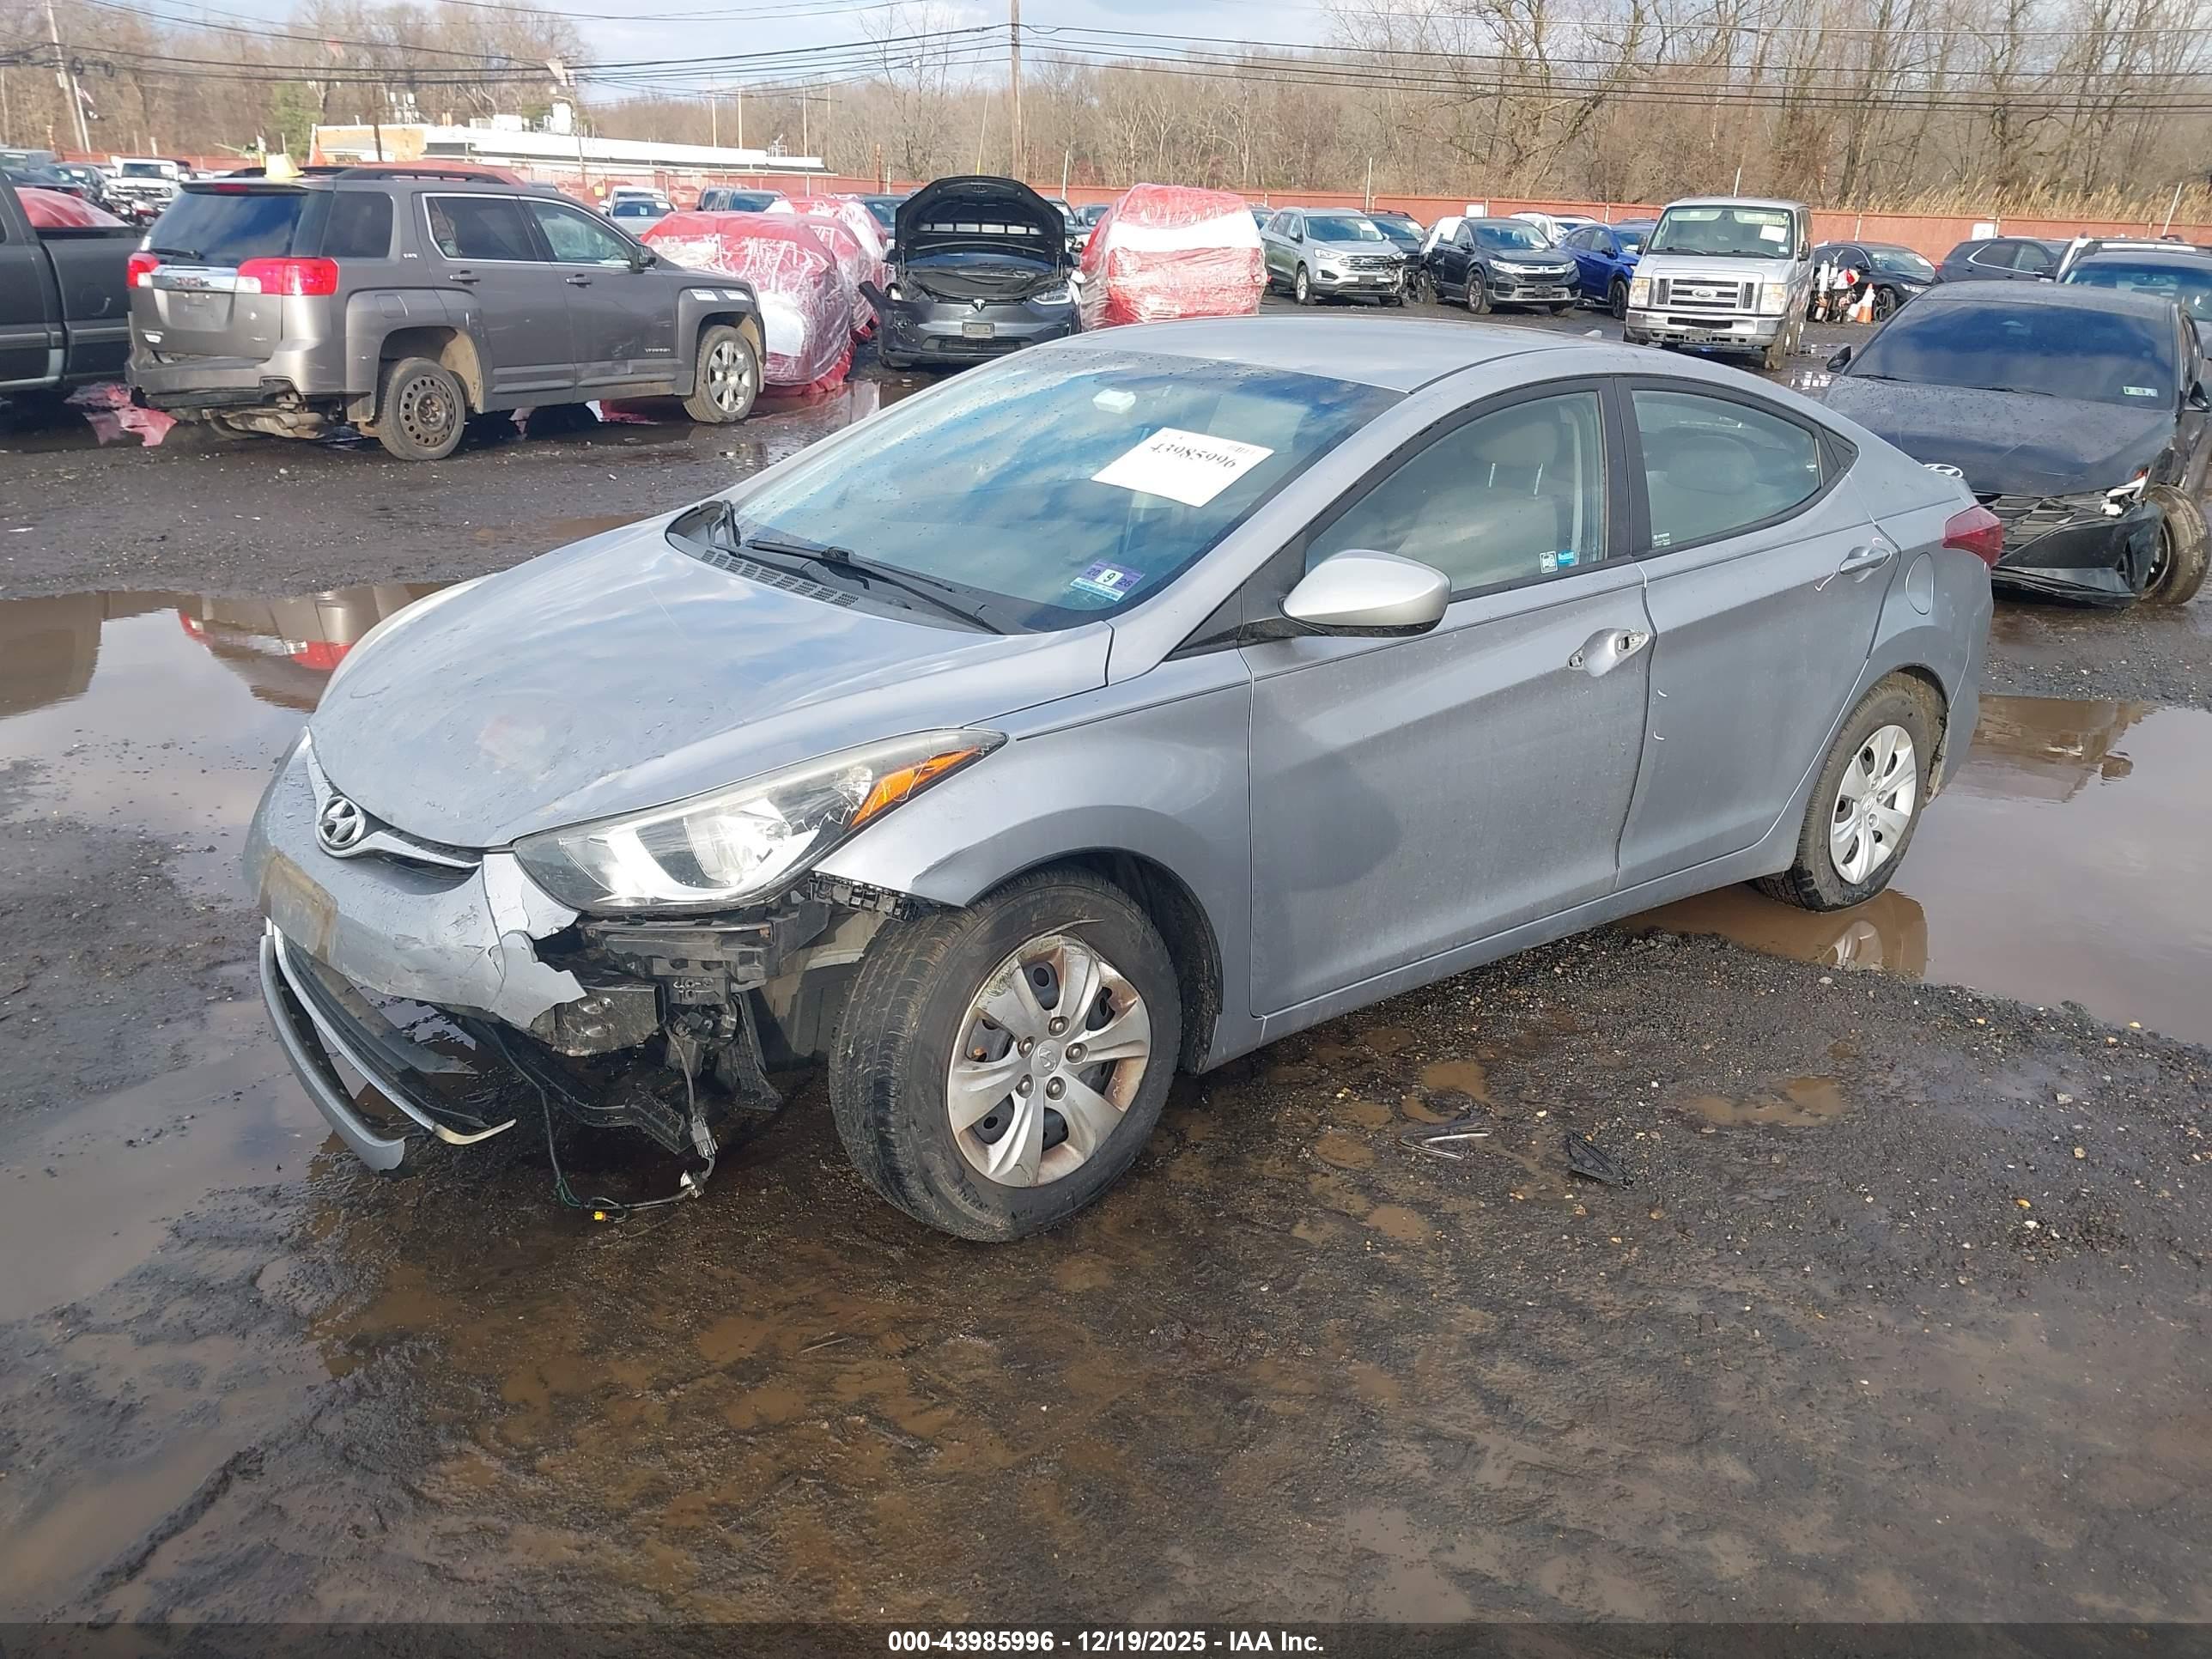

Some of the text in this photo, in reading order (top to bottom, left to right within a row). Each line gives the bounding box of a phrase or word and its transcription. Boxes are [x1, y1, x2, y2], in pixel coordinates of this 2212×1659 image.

[1087, 568, 1102, 577] 20
[1103, 572, 1116, 583] 9
[1117, 578, 1133, 587] 26
